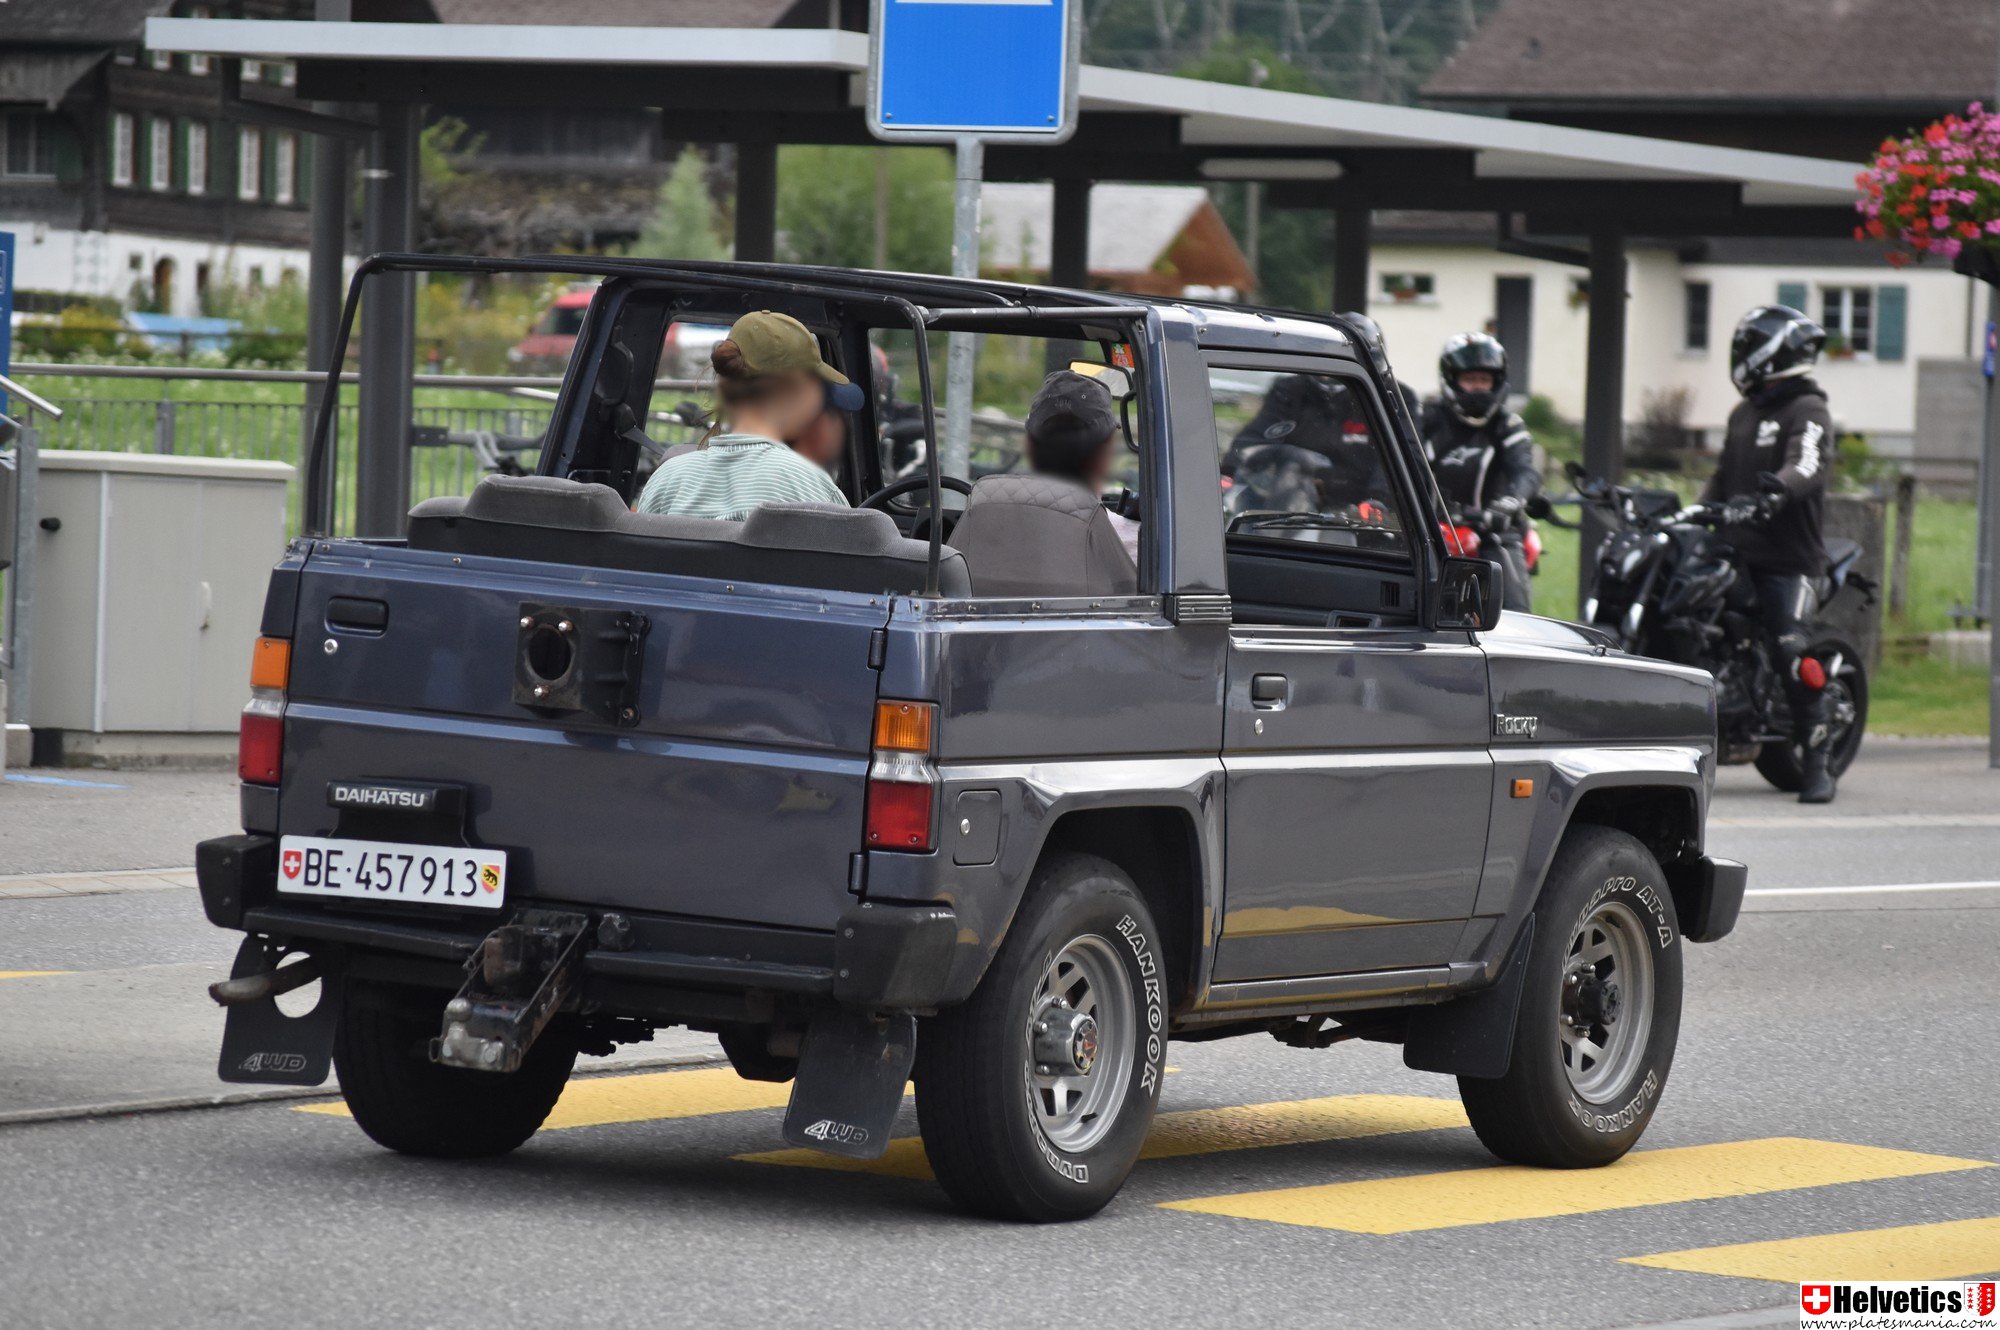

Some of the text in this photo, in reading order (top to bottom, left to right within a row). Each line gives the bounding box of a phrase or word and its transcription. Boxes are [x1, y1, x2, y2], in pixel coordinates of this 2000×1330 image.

[335, 786, 425, 807] DAIHATSU
[1636, 885, 1674, 949] AT-A
[1116, 914, 1161, 1098] HANKOOK
[238, 1052, 307, 1073] 4WD
[1567, 1068, 1659, 1133] HANKOOK
[804, 1119, 869, 1145] 4WD
